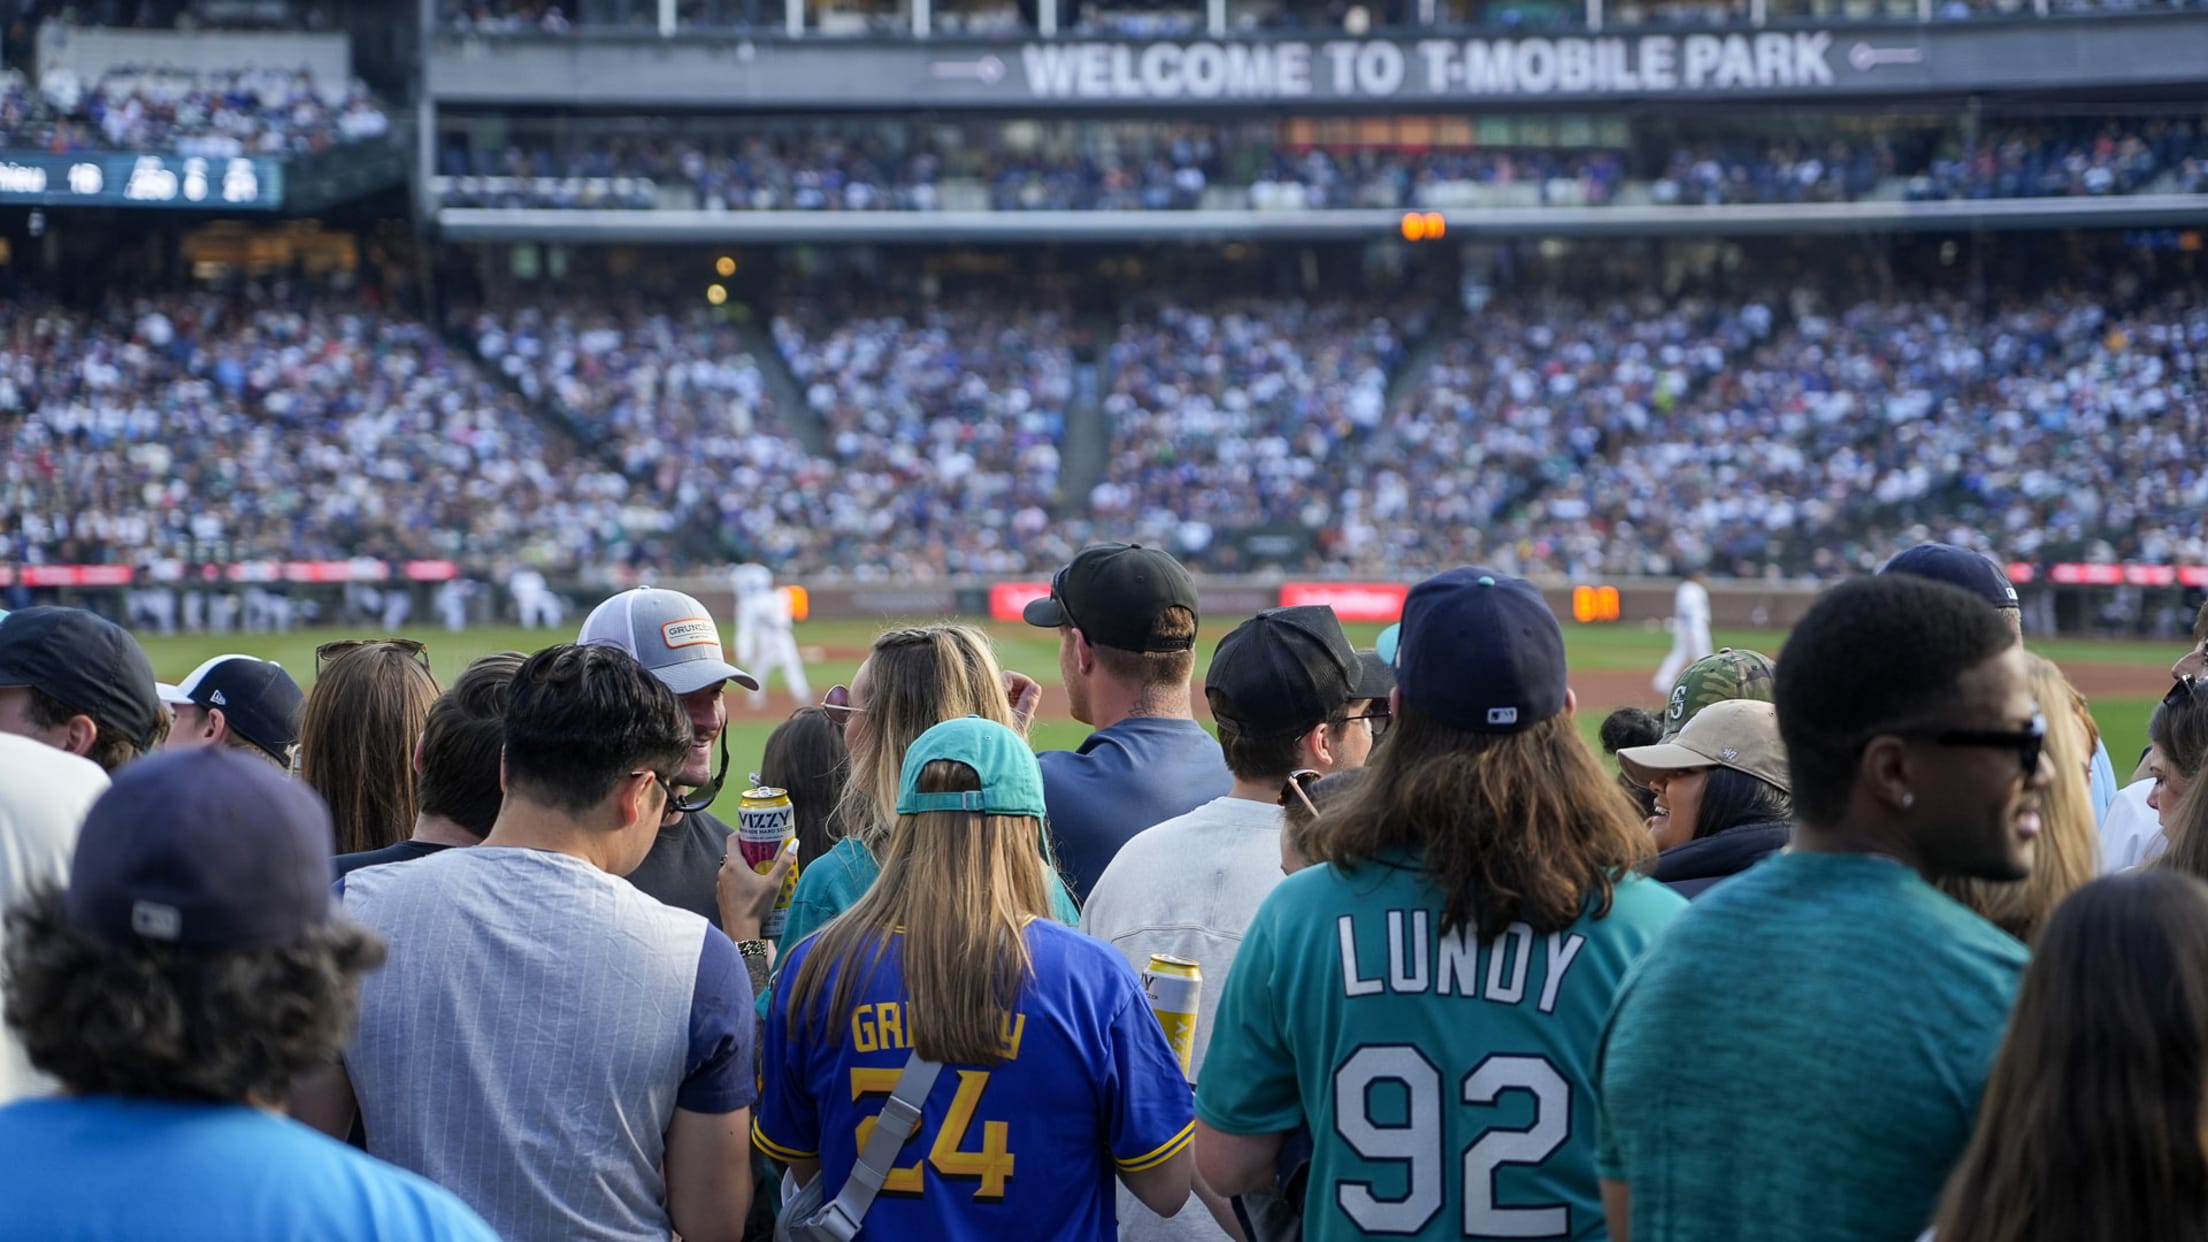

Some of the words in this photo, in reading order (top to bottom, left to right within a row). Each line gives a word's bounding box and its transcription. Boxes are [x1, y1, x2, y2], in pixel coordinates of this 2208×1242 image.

[1022, 42, 1311, 97] WELCOME
[1324, 41, 1404, 95] TO
[1417, 36, 1677, 93] T-MOBILE
[1684, 31, 1833, 87] PARK
[738, 810, 789, 828] VIZZY
[1336, 908, 1587, 1015] LUNDY
[850, 1066, 1015, 1199] 24
[1332, 1042, 1573, 1238] 92
